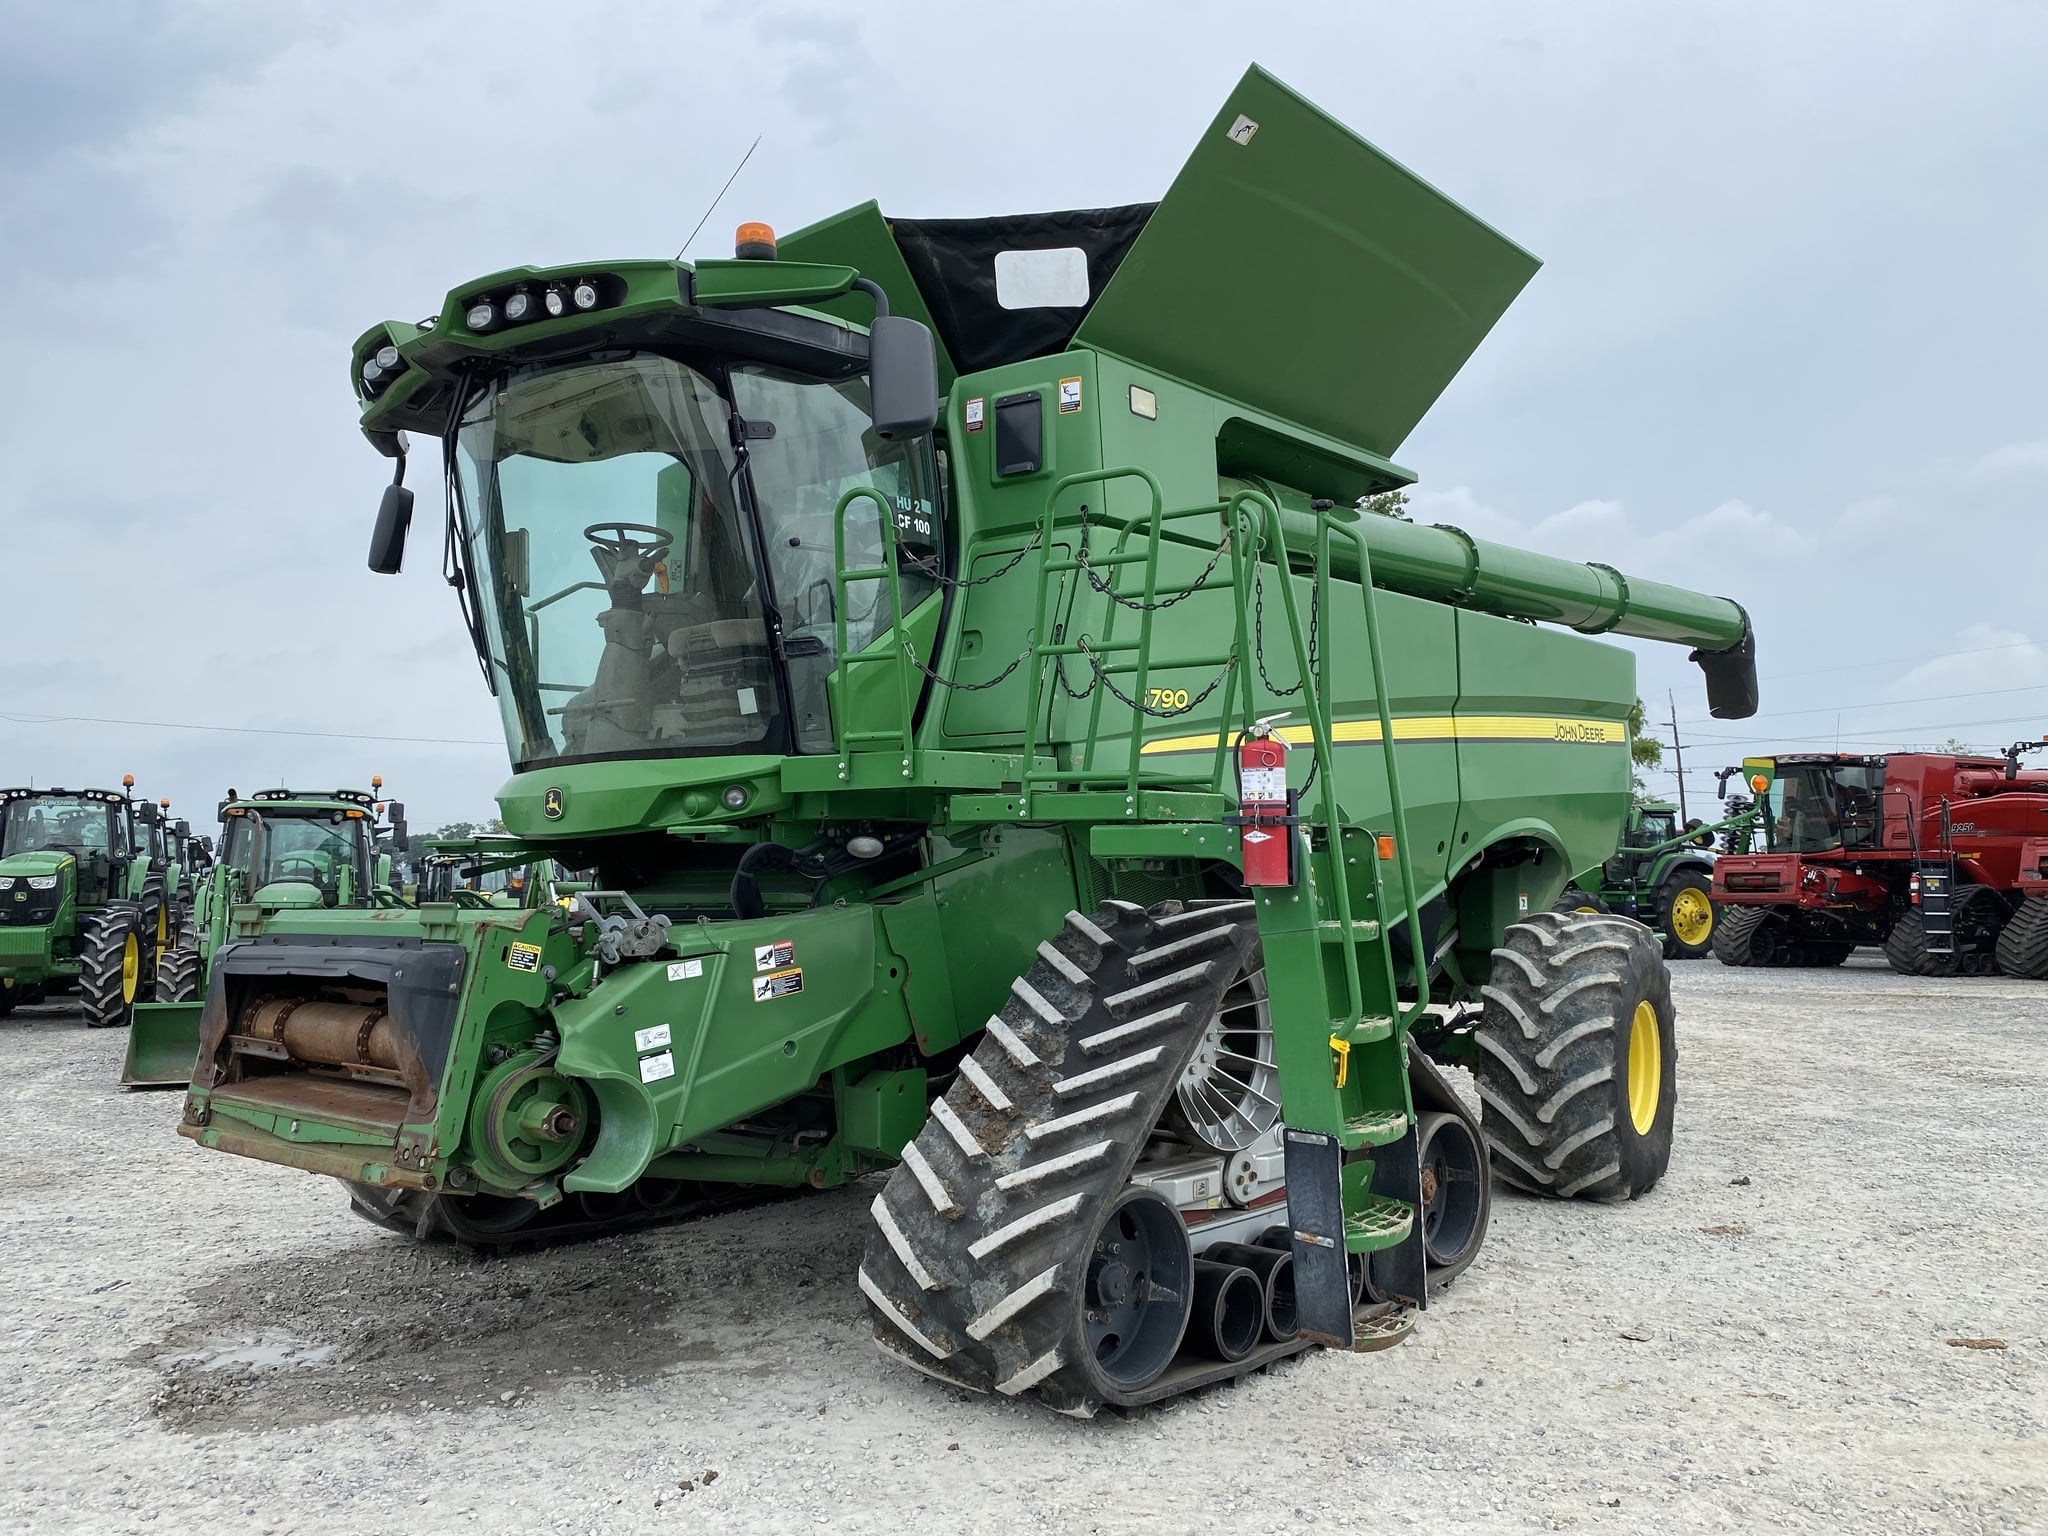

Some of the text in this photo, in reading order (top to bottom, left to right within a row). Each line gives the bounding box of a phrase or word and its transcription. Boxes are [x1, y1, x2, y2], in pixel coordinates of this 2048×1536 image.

[896, 495, 911, 511] HU
[898, 513, 931, 536] CF 100
[1554, 721, 1606, 742] JOHN DEERE
[517, 943, 540, 953] CAUTION
